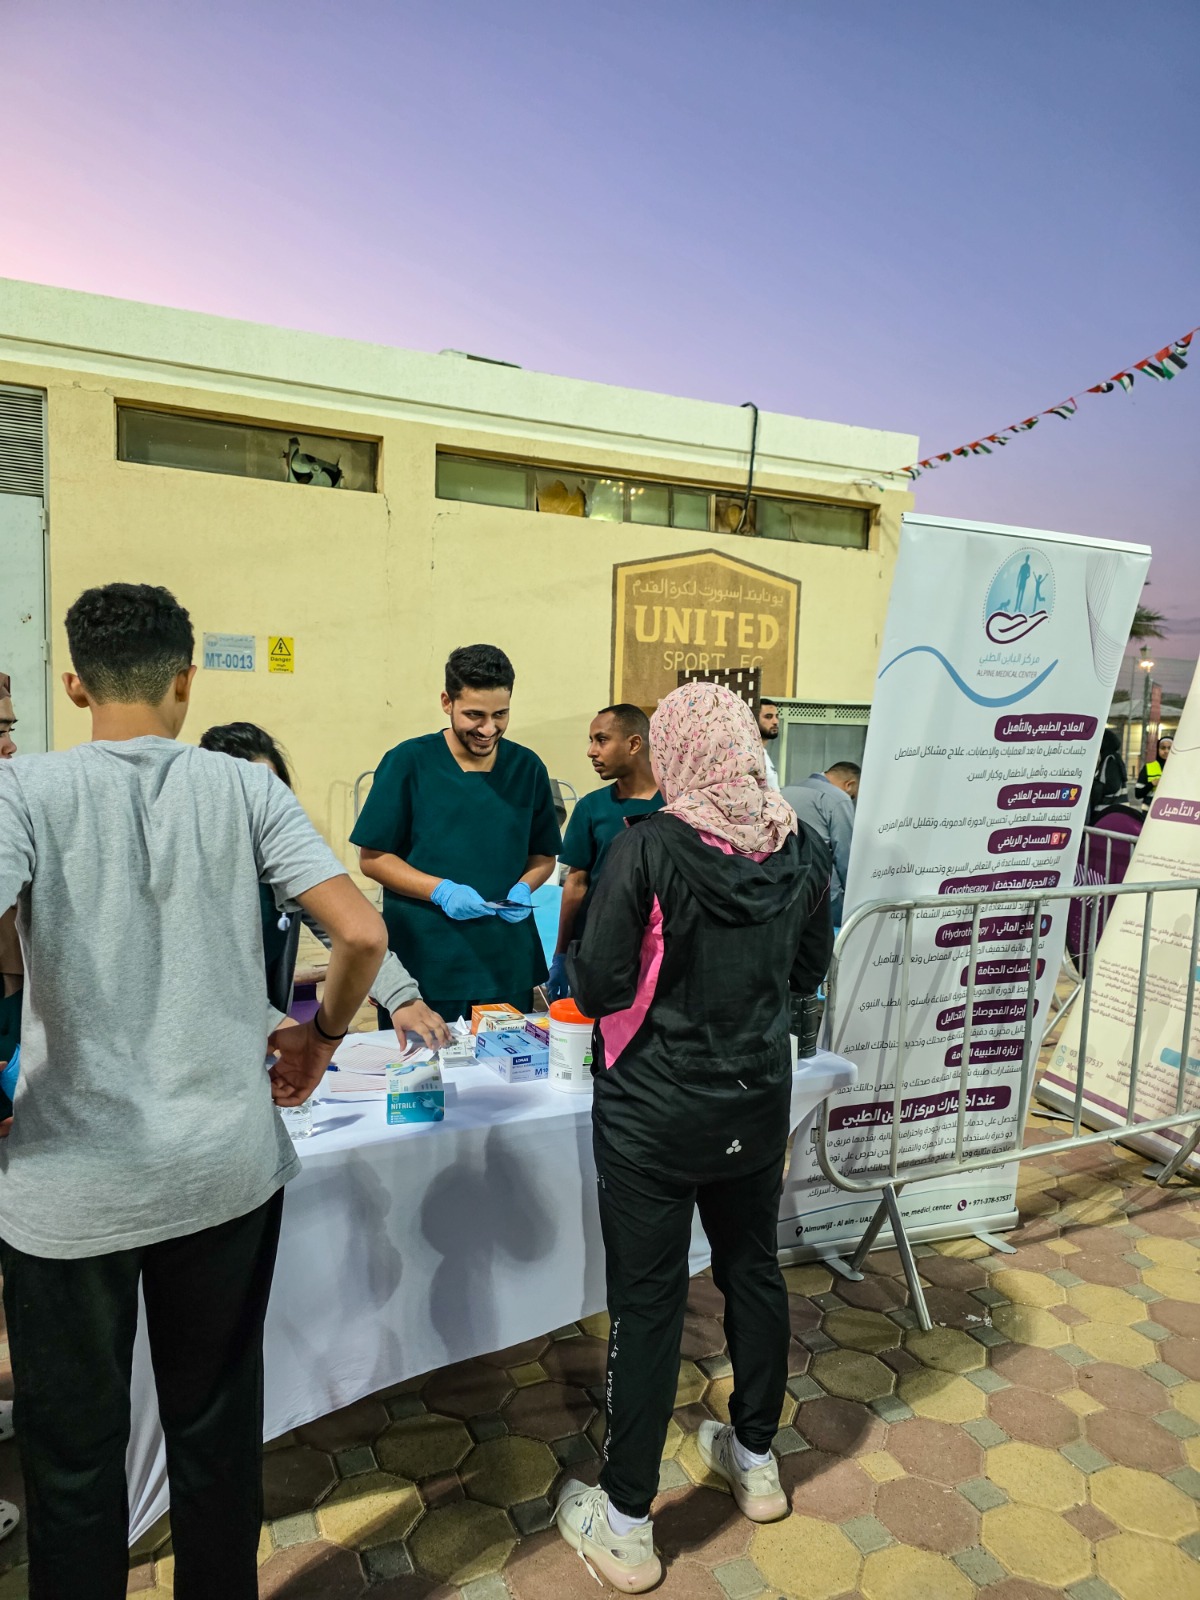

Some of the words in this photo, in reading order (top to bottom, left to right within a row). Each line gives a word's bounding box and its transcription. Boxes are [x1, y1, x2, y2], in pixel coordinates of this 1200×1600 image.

[632, 578, 668, 598] القدم
[670, 580, 696, 599] لكرة
[634, 604, 780, 650] UNITED
[205, 653, 253, 669] MT-0013
[664, 651, 725, 670] SPORT
[979, 652, 1001, 666] الطبي
[1020, 653, 1040, 666] مركز
[1003, 718, 1032, 735] والتأهيل
[1032, 722, 1060, 736] الطبيعي
[1060, 721, 1084, 736] العلاج
[894, 746, 919, 760] المفاصل
[920, 745, 946, 758] مشاكل
[948, 747, 965, 759] علاج
[1000, 746, 1025, 756] العمليات
[1044, 743, 1062, 756] تأهيل
[1062, 746, 1086, 755] جلسات
[986, 769, 1003, 780] وكبار
[1008, 790, 1031, 806] العلاجي
[1032, 790, 1060, 803] المساج
[1159, 801, 1194, 817] التأهيل
[913, 817, 938, 829] وتقليل
[966, 816, 985, 828] الدورة
[1031, 812, 1047, 822] الشد
[997, 834, 1022, 849] الرياضي
[1022, 833, 1051, 848] المساج
[895, 863, 914, 874] الأداء
[915, 864, 946, 876] وتحسين
[948, 862, 969, 874] السريع
[995, 880, 1026, 890] المتجمدة
[916, 910, 940, 919] الشفاء
[962, 904, 988, 916] العلات
[942, 925, 989, 940] (Hydrothapy
[996, 922, 1020, 936] المائي
[1020, 922, 1034, 935] علاج
[924, 951, 952, 964] المفاصل
[978, 965, 1005, 976] الحجامة
[973, 987, 995, 997] الدموي
[996, 986, 1014, 996] الدورة
[1010, 1004, 1026, 1016] إجراء
[941, 1010, 966, 1025] التحاليل
[989, 1028, 1010, 1037] مخبرية
[1011, 1025, 1026, 1035] حاليل
[927, 1036, 946, 1045] صحتك
[948, 1032, 964, 1042] متابعة
[871, 1040, 899, 1051] حتياجاتك
[854, 1082, 874, 1091] حالتك
[875, 1080, 908, 1092] وتخيص
[910, 1078, 930, 1087] صحتك
[937, 1094, 975, 1112] اخيارك
[976, 1094, 995, 1106] عند
[882, 1103, 912, 1124] ألبين
[912, 1104, 936, 1120] مركز
[842, 1109, 880, 1129] الطبي
[985, 1117, 996, 1127] على
[942, 1122, 957, 1130] لاجية
[852, 1134, 876, 1143] يقدمها
[899, 1128, 923, 1139] واحترافي
[991, 1131, 1004, 1141] خبرة
[834, 1139, 850, 1147] فريق
[922, 1138, 943, 1150] الأجهزة
[841, 1152, 854, 1162] على
[935, 1152, 948, 1163] علاج
